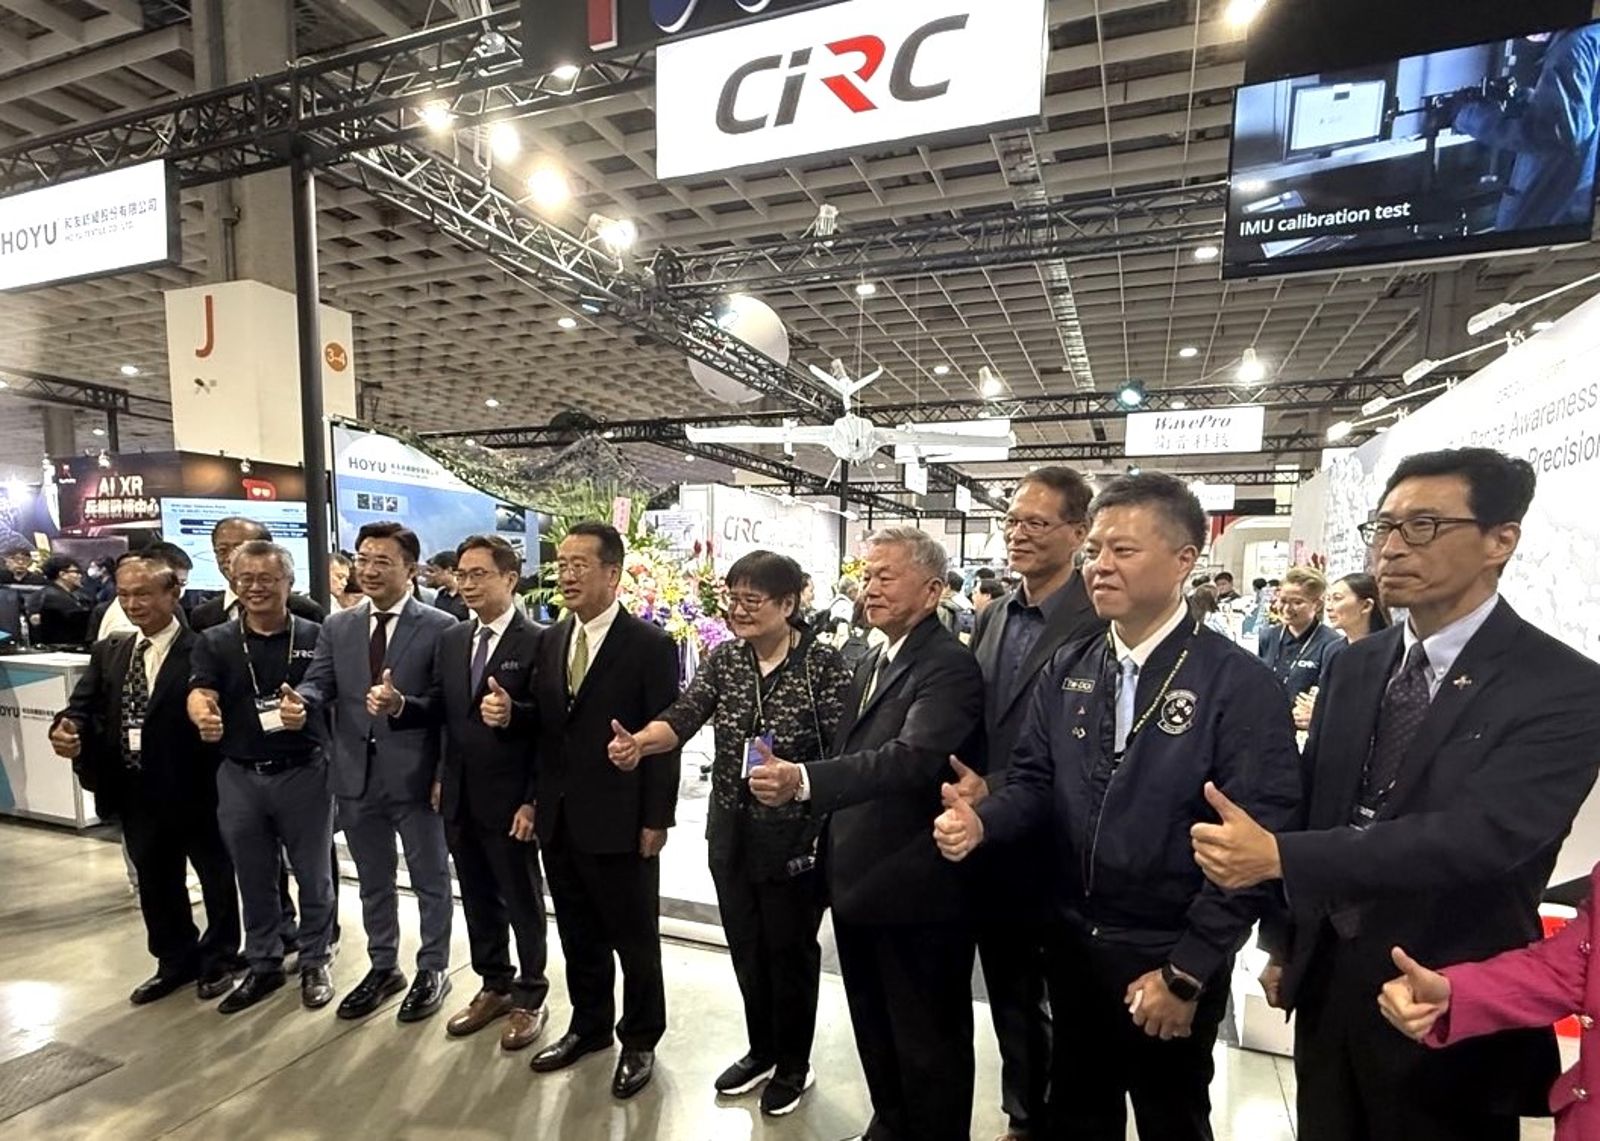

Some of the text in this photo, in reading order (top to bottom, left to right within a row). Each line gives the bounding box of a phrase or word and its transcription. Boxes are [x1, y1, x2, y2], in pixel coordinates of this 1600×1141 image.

[1239, 202, 1411, 236] IMU calibration test
[1, 221, 57, 255] HOYU
[195, 295, 214, 358] J
[327, 347, 346, 366] 3-4
[1508, 382, 1598, 440] Awareness
[1155, 415, 1231, 430] WavePro
[348, 457, 387, 474] HOYU
[98, 475, 143, 497] AI XR
[0, 706, 20, 718] OYU
